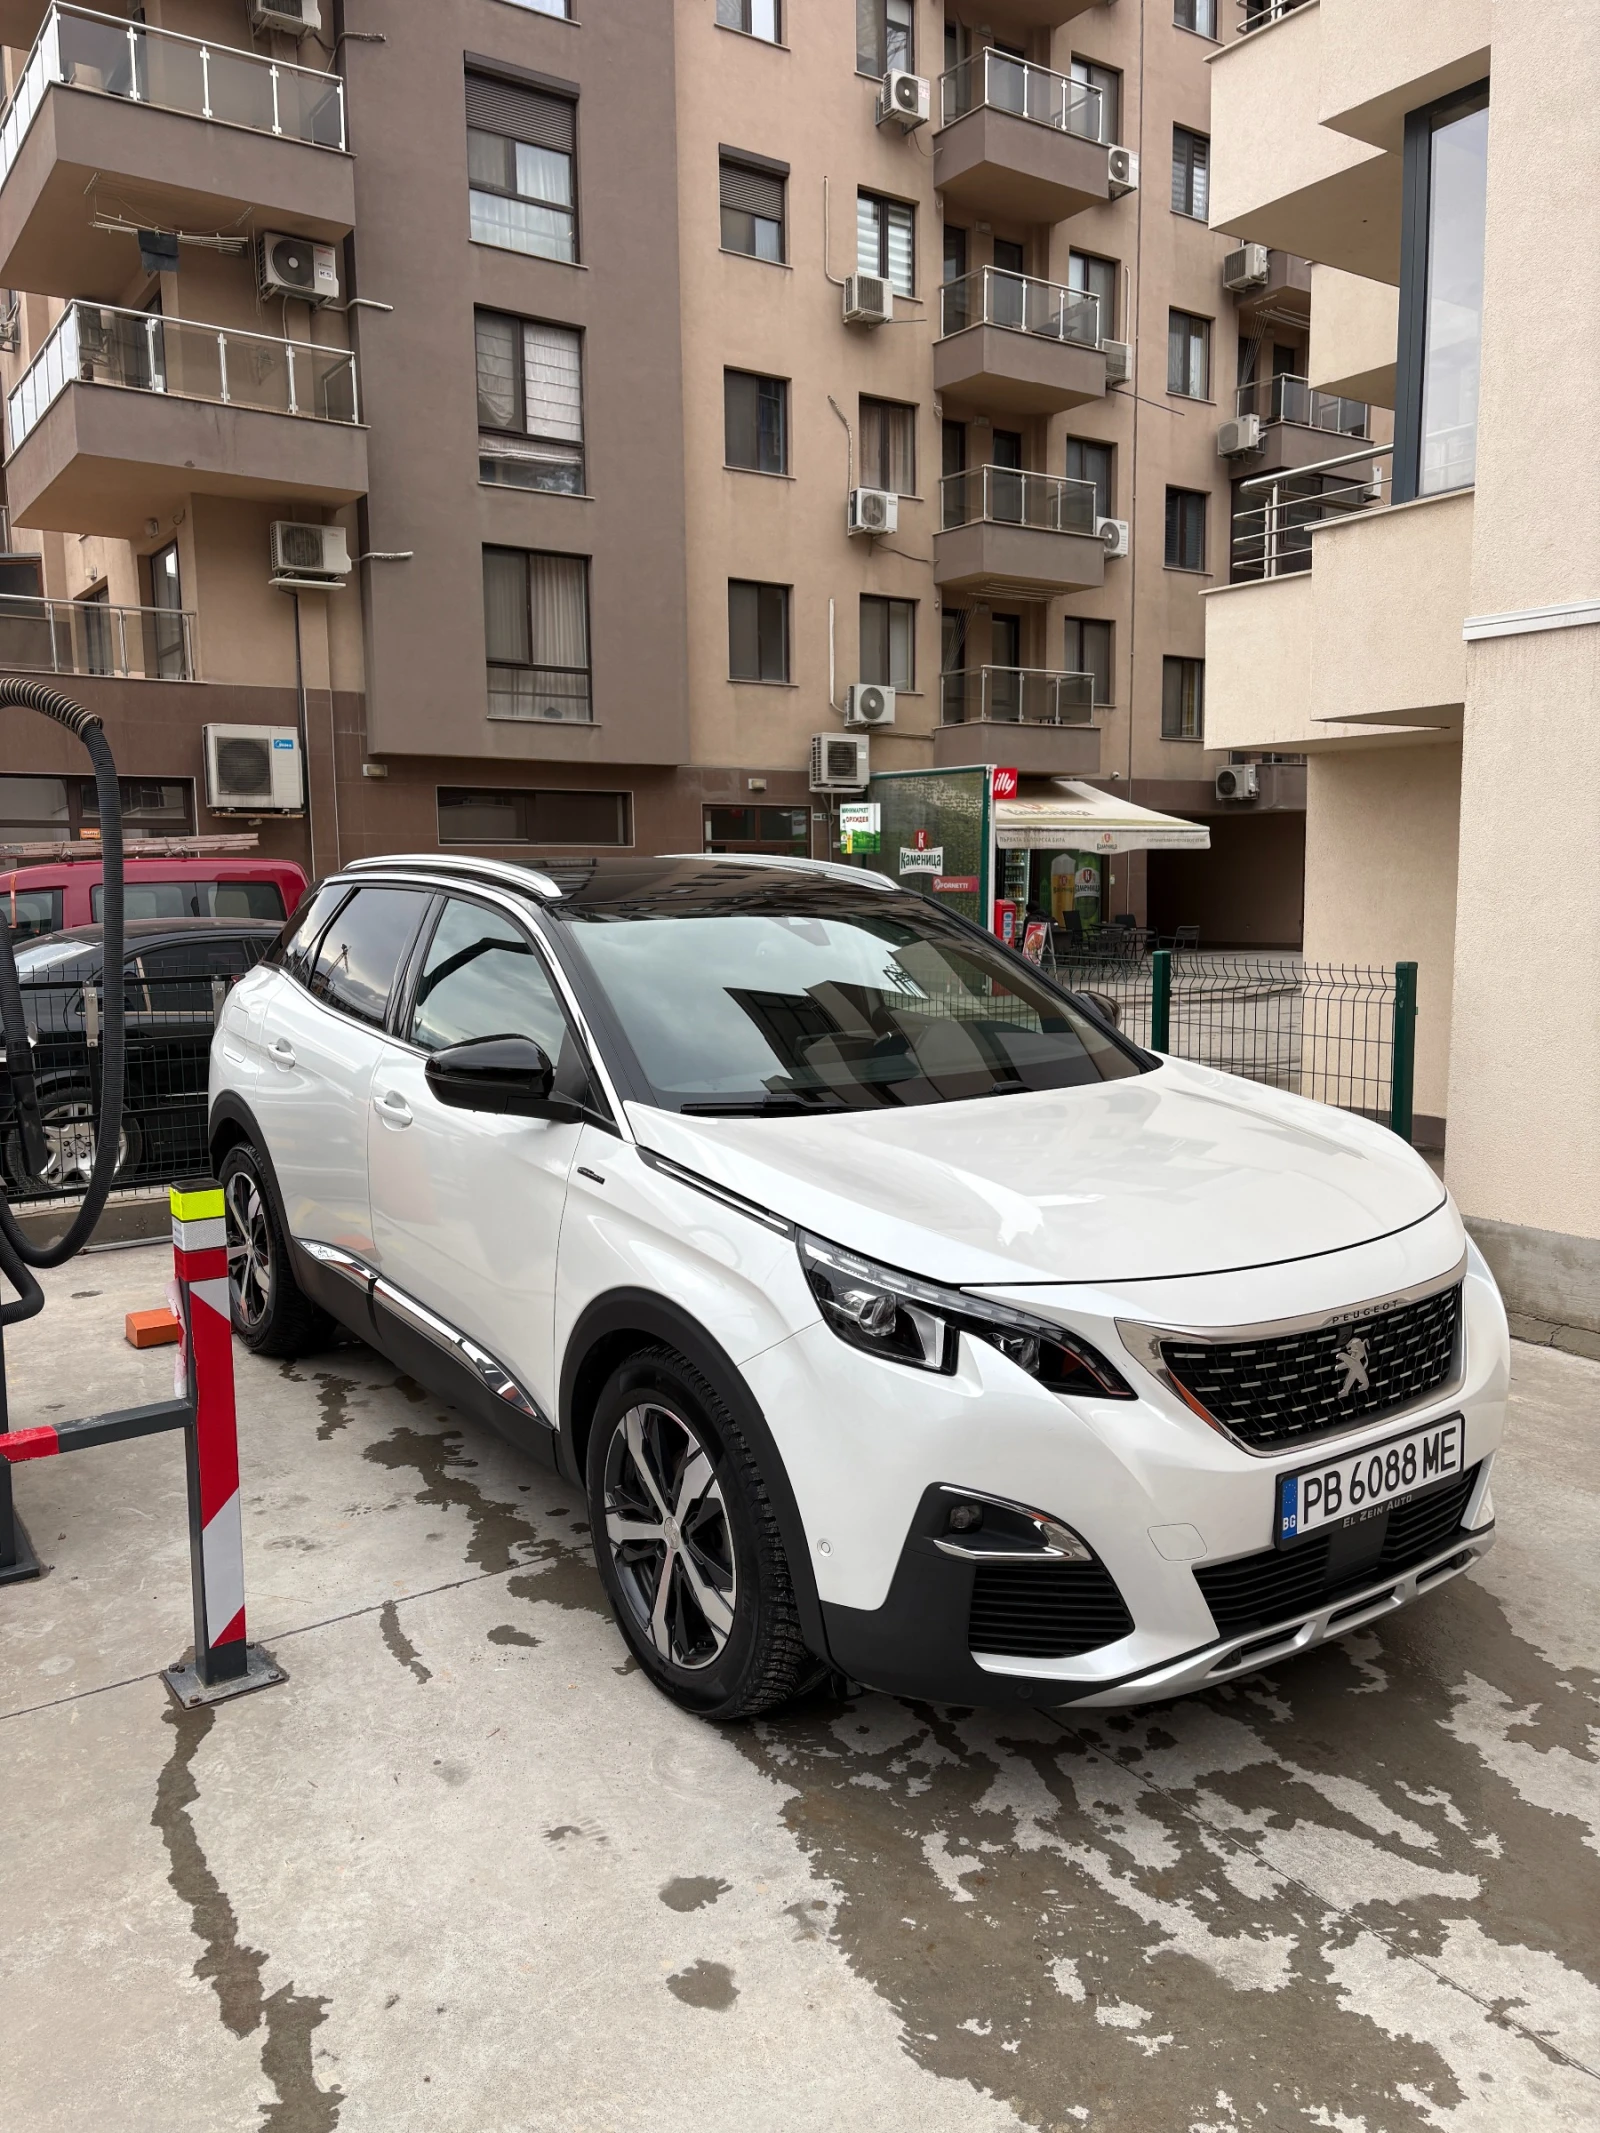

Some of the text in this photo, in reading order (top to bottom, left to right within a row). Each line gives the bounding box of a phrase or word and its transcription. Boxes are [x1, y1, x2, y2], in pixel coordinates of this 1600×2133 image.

[994, 772, 1015, 795] illy
[901, 852, 941, 869] Каменица
[940, 881, 969, 889] FORNETTI
[1332, 1299, 1399, 1324] PEUGEOT
[1282, 1426, 1457, 1530] BG PB 6088 ME
[1342, 1494, 1413, 1528] EL ZEIN AUTO
